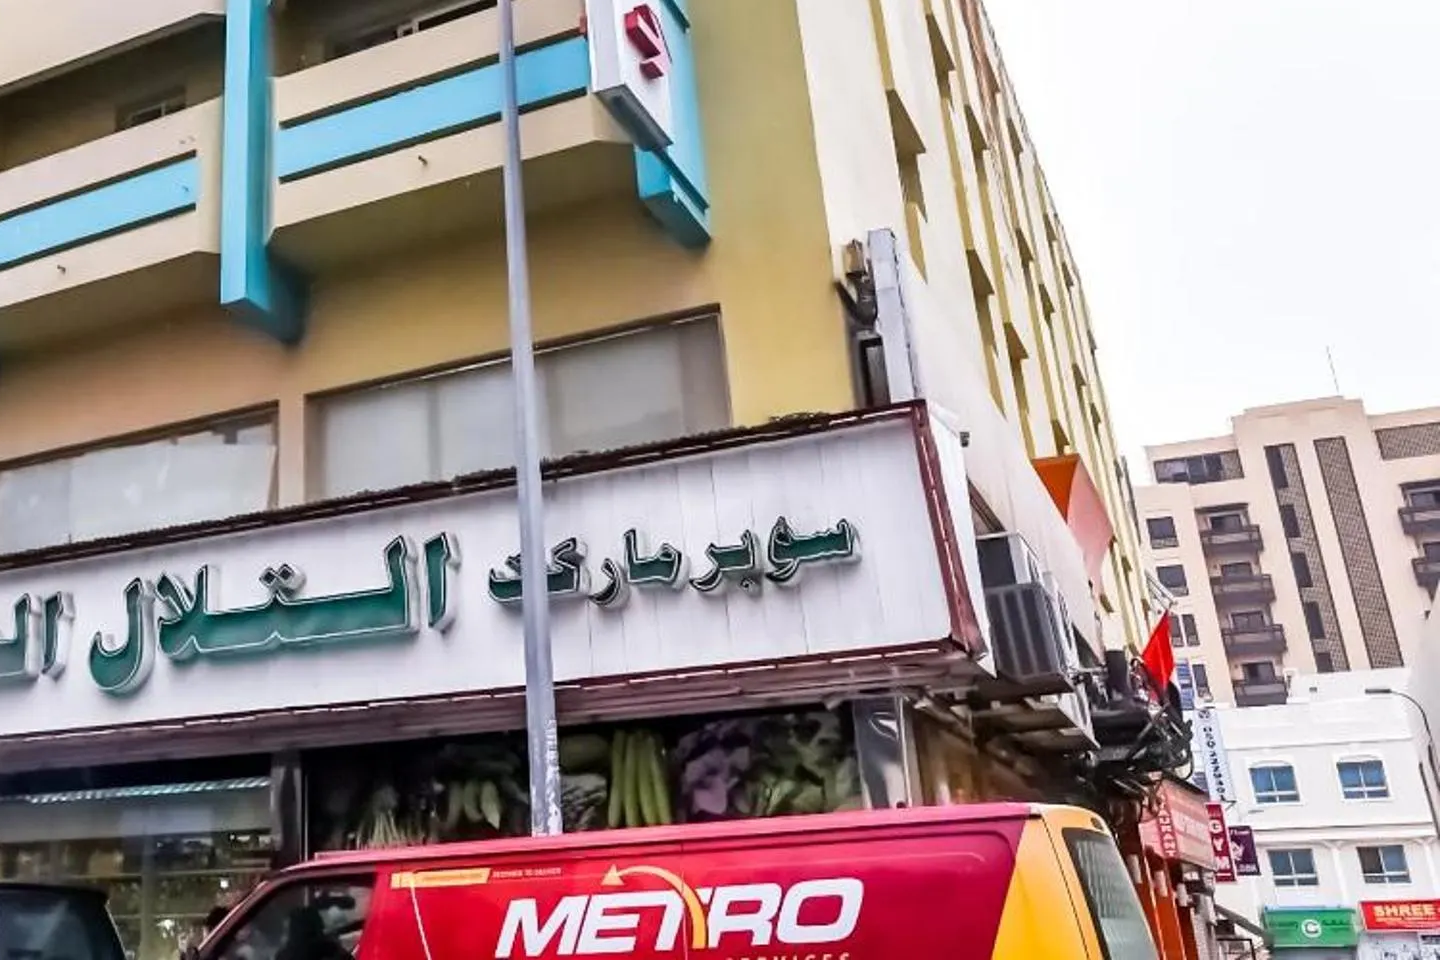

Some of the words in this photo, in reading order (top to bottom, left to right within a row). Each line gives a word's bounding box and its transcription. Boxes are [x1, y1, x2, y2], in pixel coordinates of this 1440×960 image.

[690, 515, 857, 593] سوبر
[90, 532, 454, 695] التلال
[1208, 819, 1231, 870] GYM
[495, 878, 864, 958] METRO
